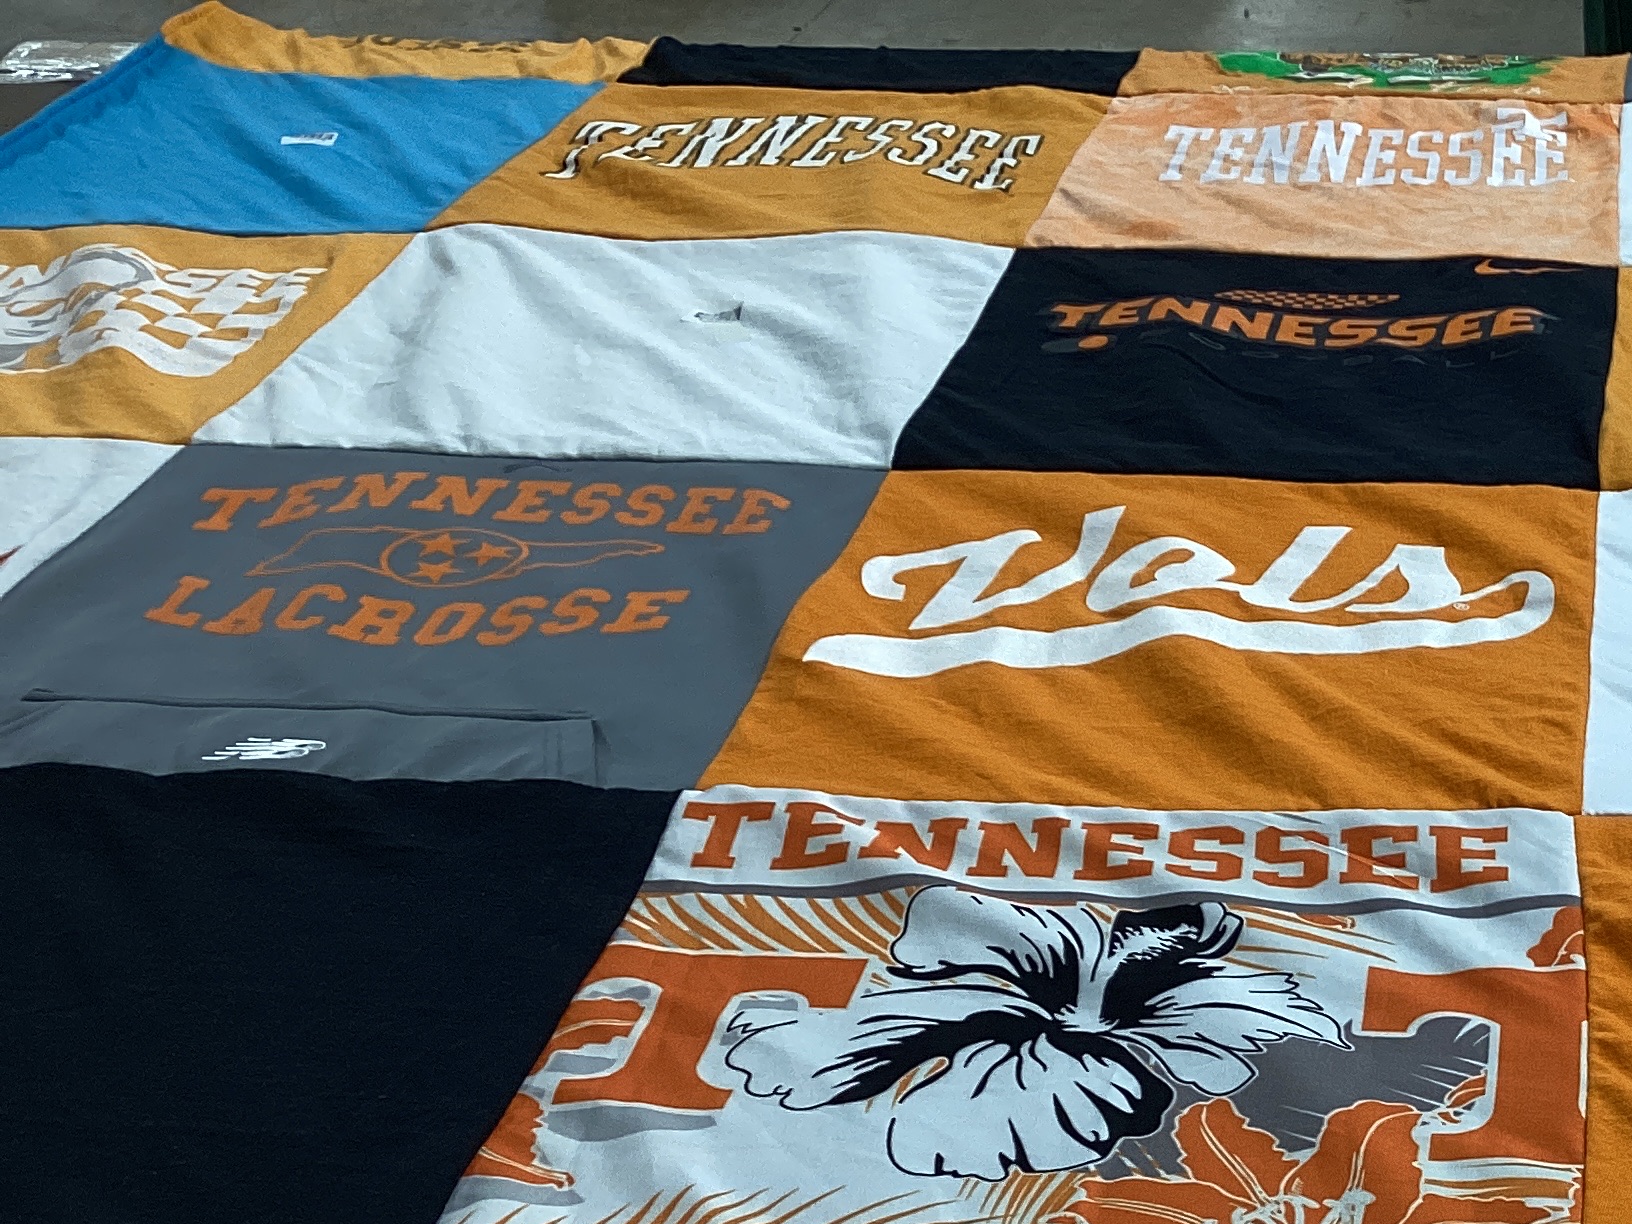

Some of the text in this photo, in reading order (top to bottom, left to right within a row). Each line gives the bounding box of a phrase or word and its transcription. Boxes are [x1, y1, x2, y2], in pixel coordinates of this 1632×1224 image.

[543, 113, 1042, 192] TENNESSEE
[1158, 107, 1569, 188] TENNESSEE
[1050, 297, 1545, 348] TENNESSEE
[193, 471, 792, 535] TENNESSEE
[144, 575, 692, 648] LACROSSE
[803, 505, 1557, 679] Vols
[680, 799, 1511, 894] TENNESSEE
